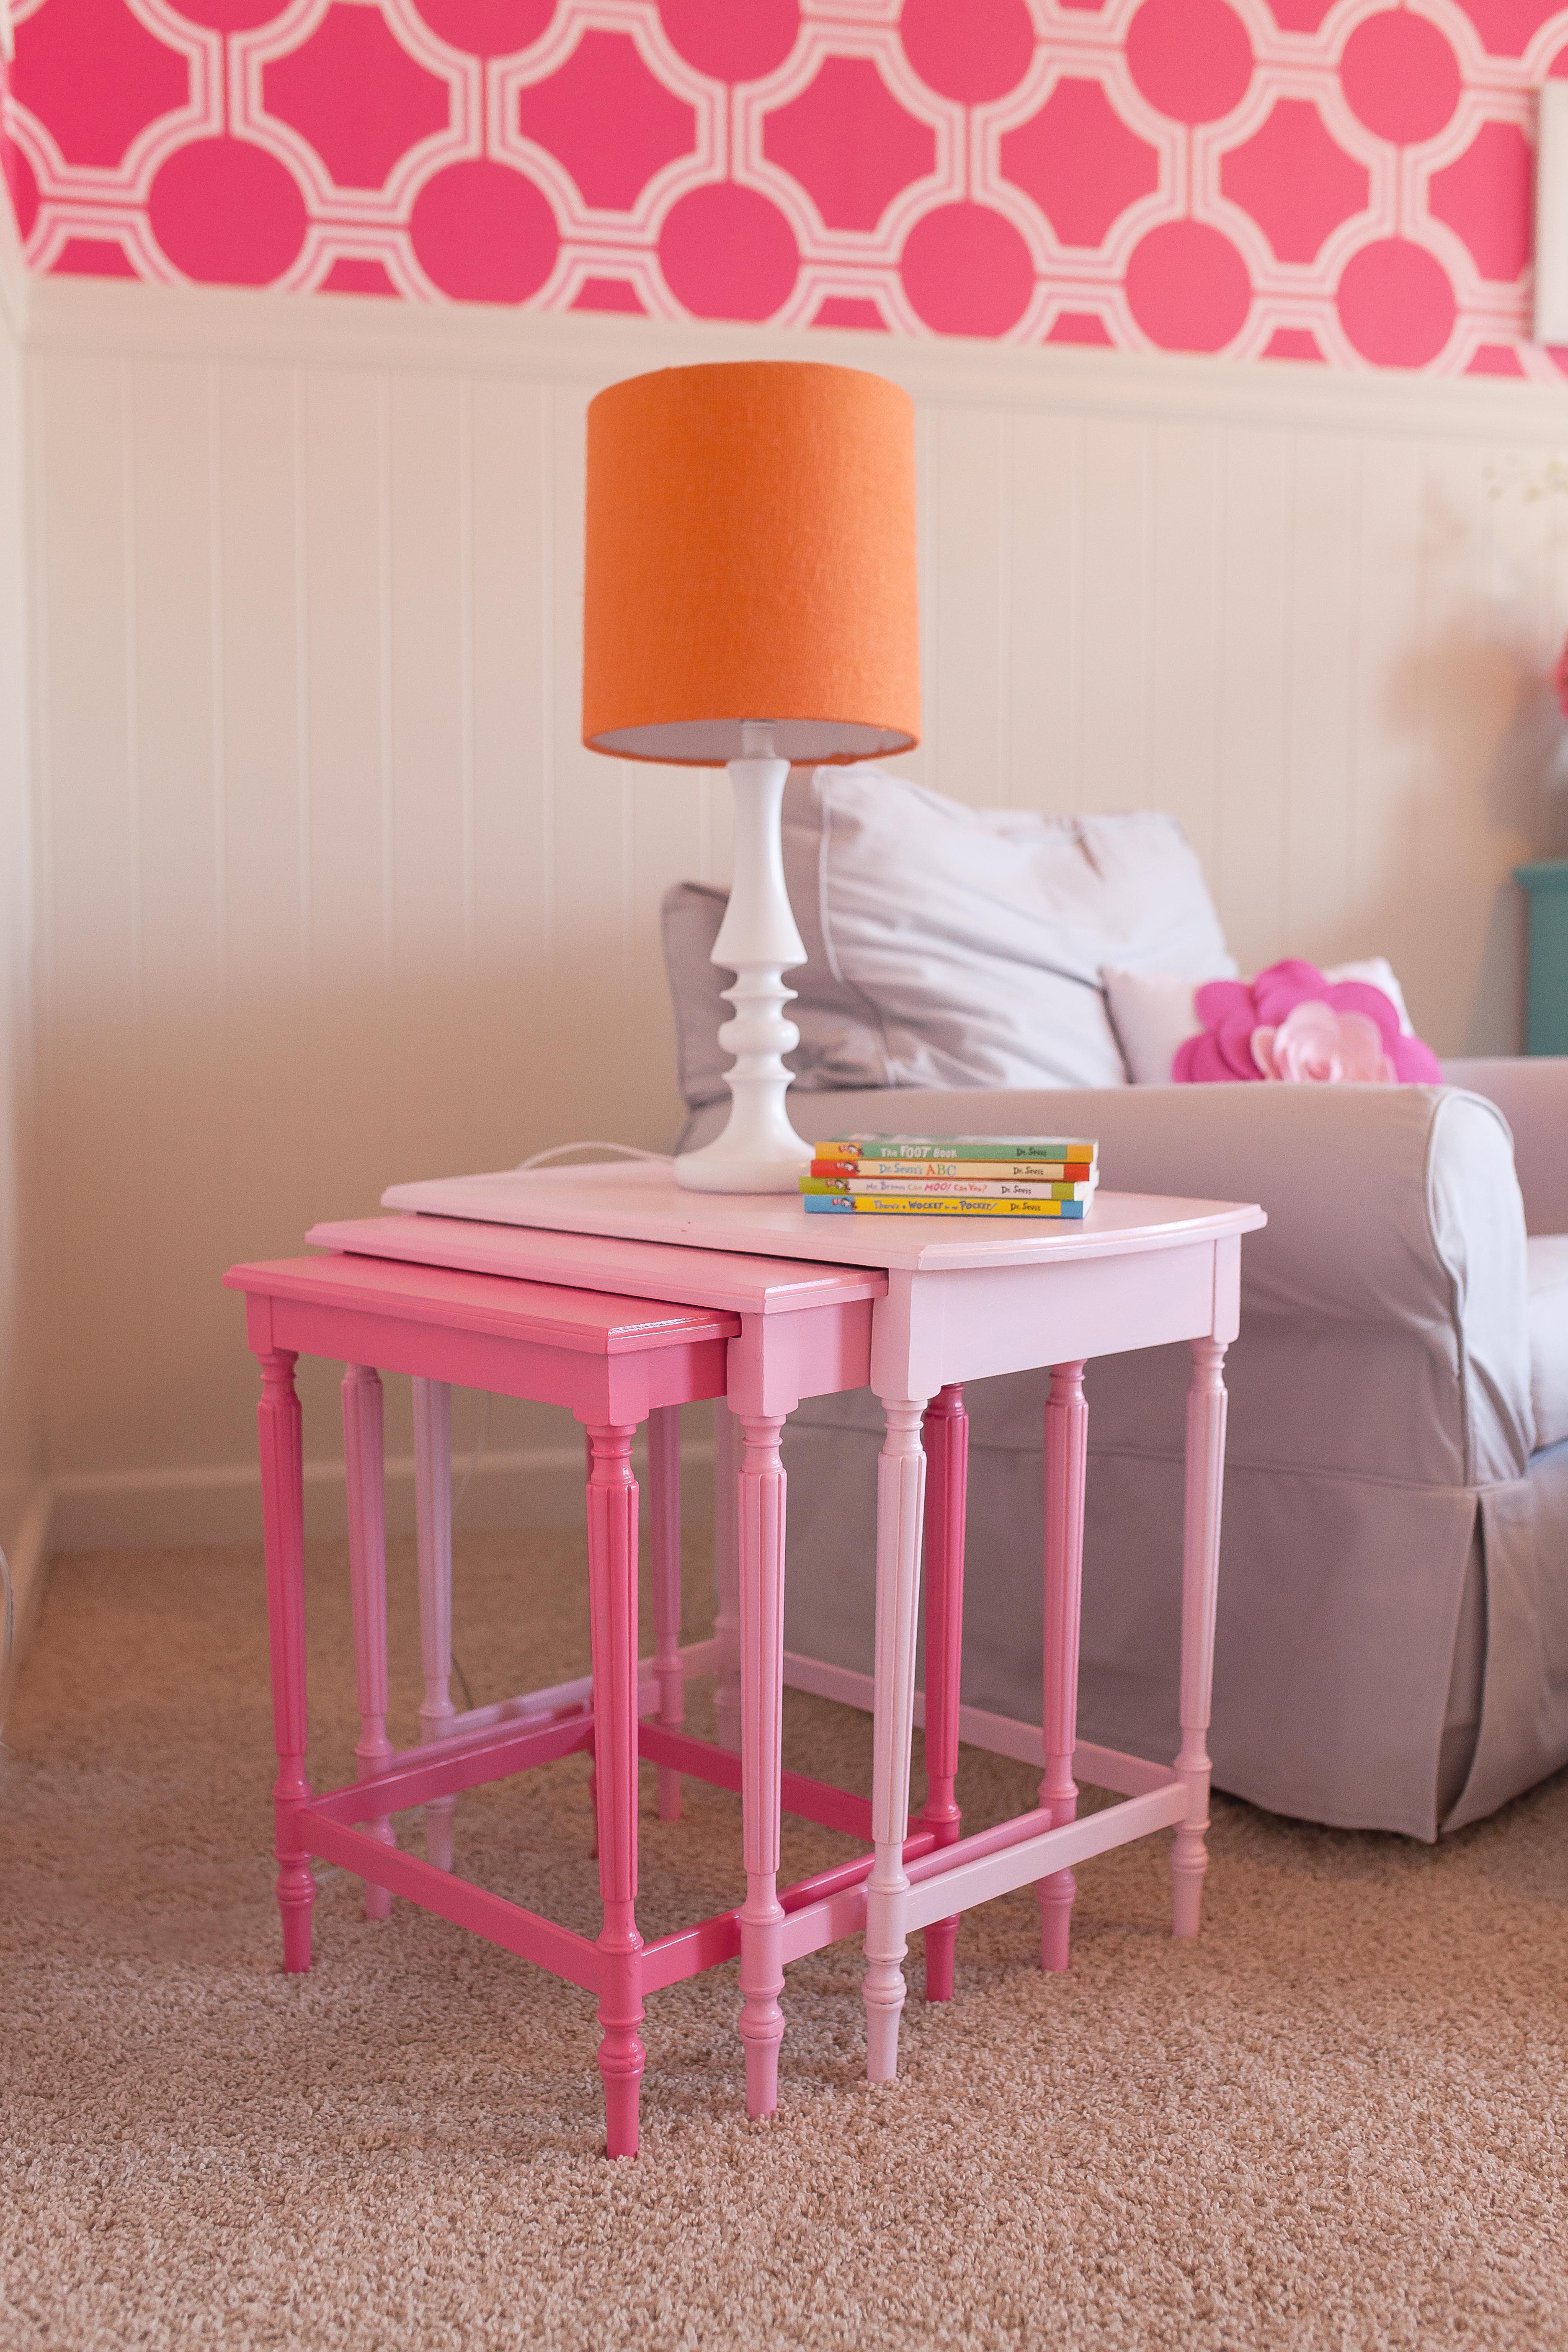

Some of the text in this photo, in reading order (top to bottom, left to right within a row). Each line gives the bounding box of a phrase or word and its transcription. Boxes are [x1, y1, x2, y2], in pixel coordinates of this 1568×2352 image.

[900, 1145, 931, 1158] FOOT
[1028, 1147, 1047, 1157] Seuss
[879, 1162, 957, 1177] Dr. Seuss's ABC
[1025, 1166, 1043, 1176] Seuss
[924, 1182, 952, 1191] MOO!
[953, 1183, 968, 1191] Can
[1001, 1185, 1032, 1195] Dr. Seuss
[873, 1199, 900, 1209] There's
[908, 1200, 943, 1210] WOCKET
[959, 1199, 998, 1211] POCKET!
[1022, 1202, 1041, 1211] Seuss
